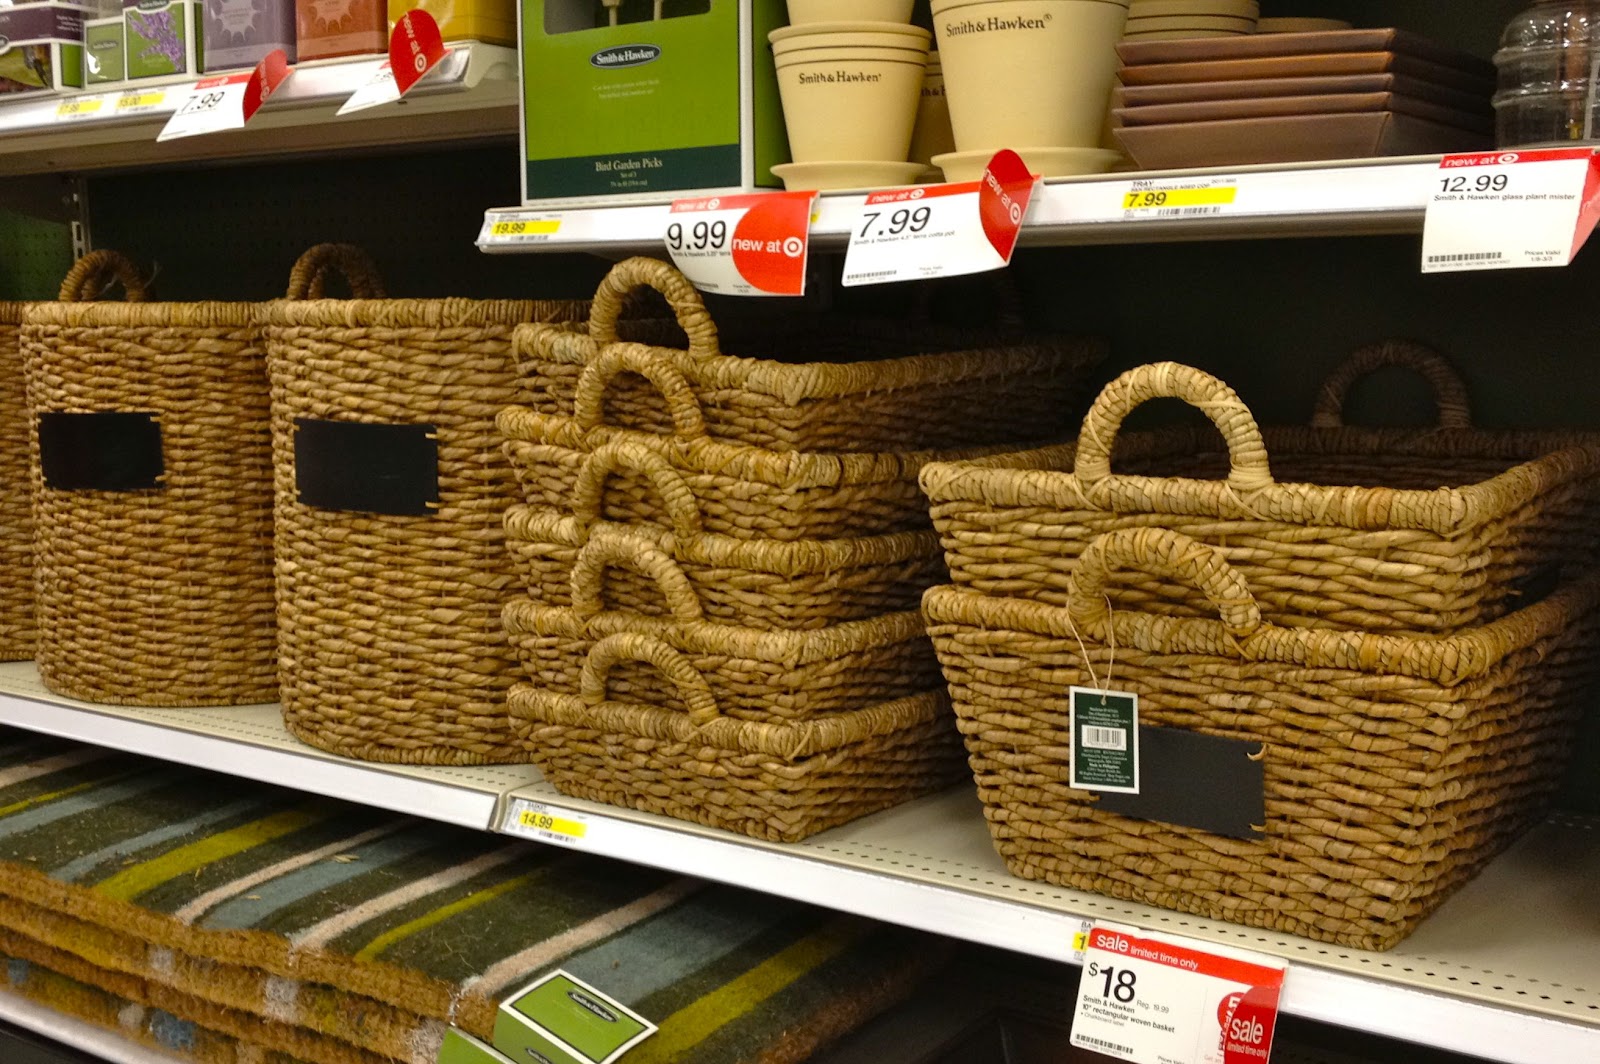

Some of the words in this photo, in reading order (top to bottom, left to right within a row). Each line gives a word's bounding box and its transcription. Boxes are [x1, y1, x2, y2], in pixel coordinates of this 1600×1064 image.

[181, 91, 225, 112] 7.99
[595, 161, 612, 172] Bird
[613, 159, 641, 170] Garden
[642, 157, 663, 168] Picks
[1445, 157, 1476, 167] new
[1480, 156, 1495, 165] at
[985, 168, 1003, 196] new
[1001, 193, 1012, 210] at
[1440, 174, 1508, 192] 12.99
[871, 194, 896, 203] new
[897, 192, 909, 200] at
[1129, 192, 1167, 207] 7.99
[1502, 194, 1523, 202] glass
[1525, 193, 1547, 201] plant
[494, 222, 526, 234] 19.99
[860, 206, 931, 238] 7.99
[667, 220, 727, 250] 9.99
[732, 238, 763, 252] new
[766, 239, 781, 253] at
[523, 813, 553, 829] 14.99
[1096, 934, 1129, 952] sale
[1131, 946, 1158, 960] limited
[1160, 952, 1178, 964] time
[1180, 958, 1199, 971] only
[1083, 994, 1102, 1005] Smith
[1109, 1002, 1135, 1014] Hawken
[1137, 999, 1150, 1010] Reg.
[1153, 1004, 1170, 1014] 19.99
[1093, 1006, 1129, 1021] rectangular
[1130, 1016, 1151, 1027] woven
[1152, 1020, 1175, 1033] basket
[1230, 1015, 1264, 1045] sale
[1227, 1041, 1245, 1053] limited
[1245, 1045, 1257, 1055] time
[1256, 1049, 1267, 1060] only
